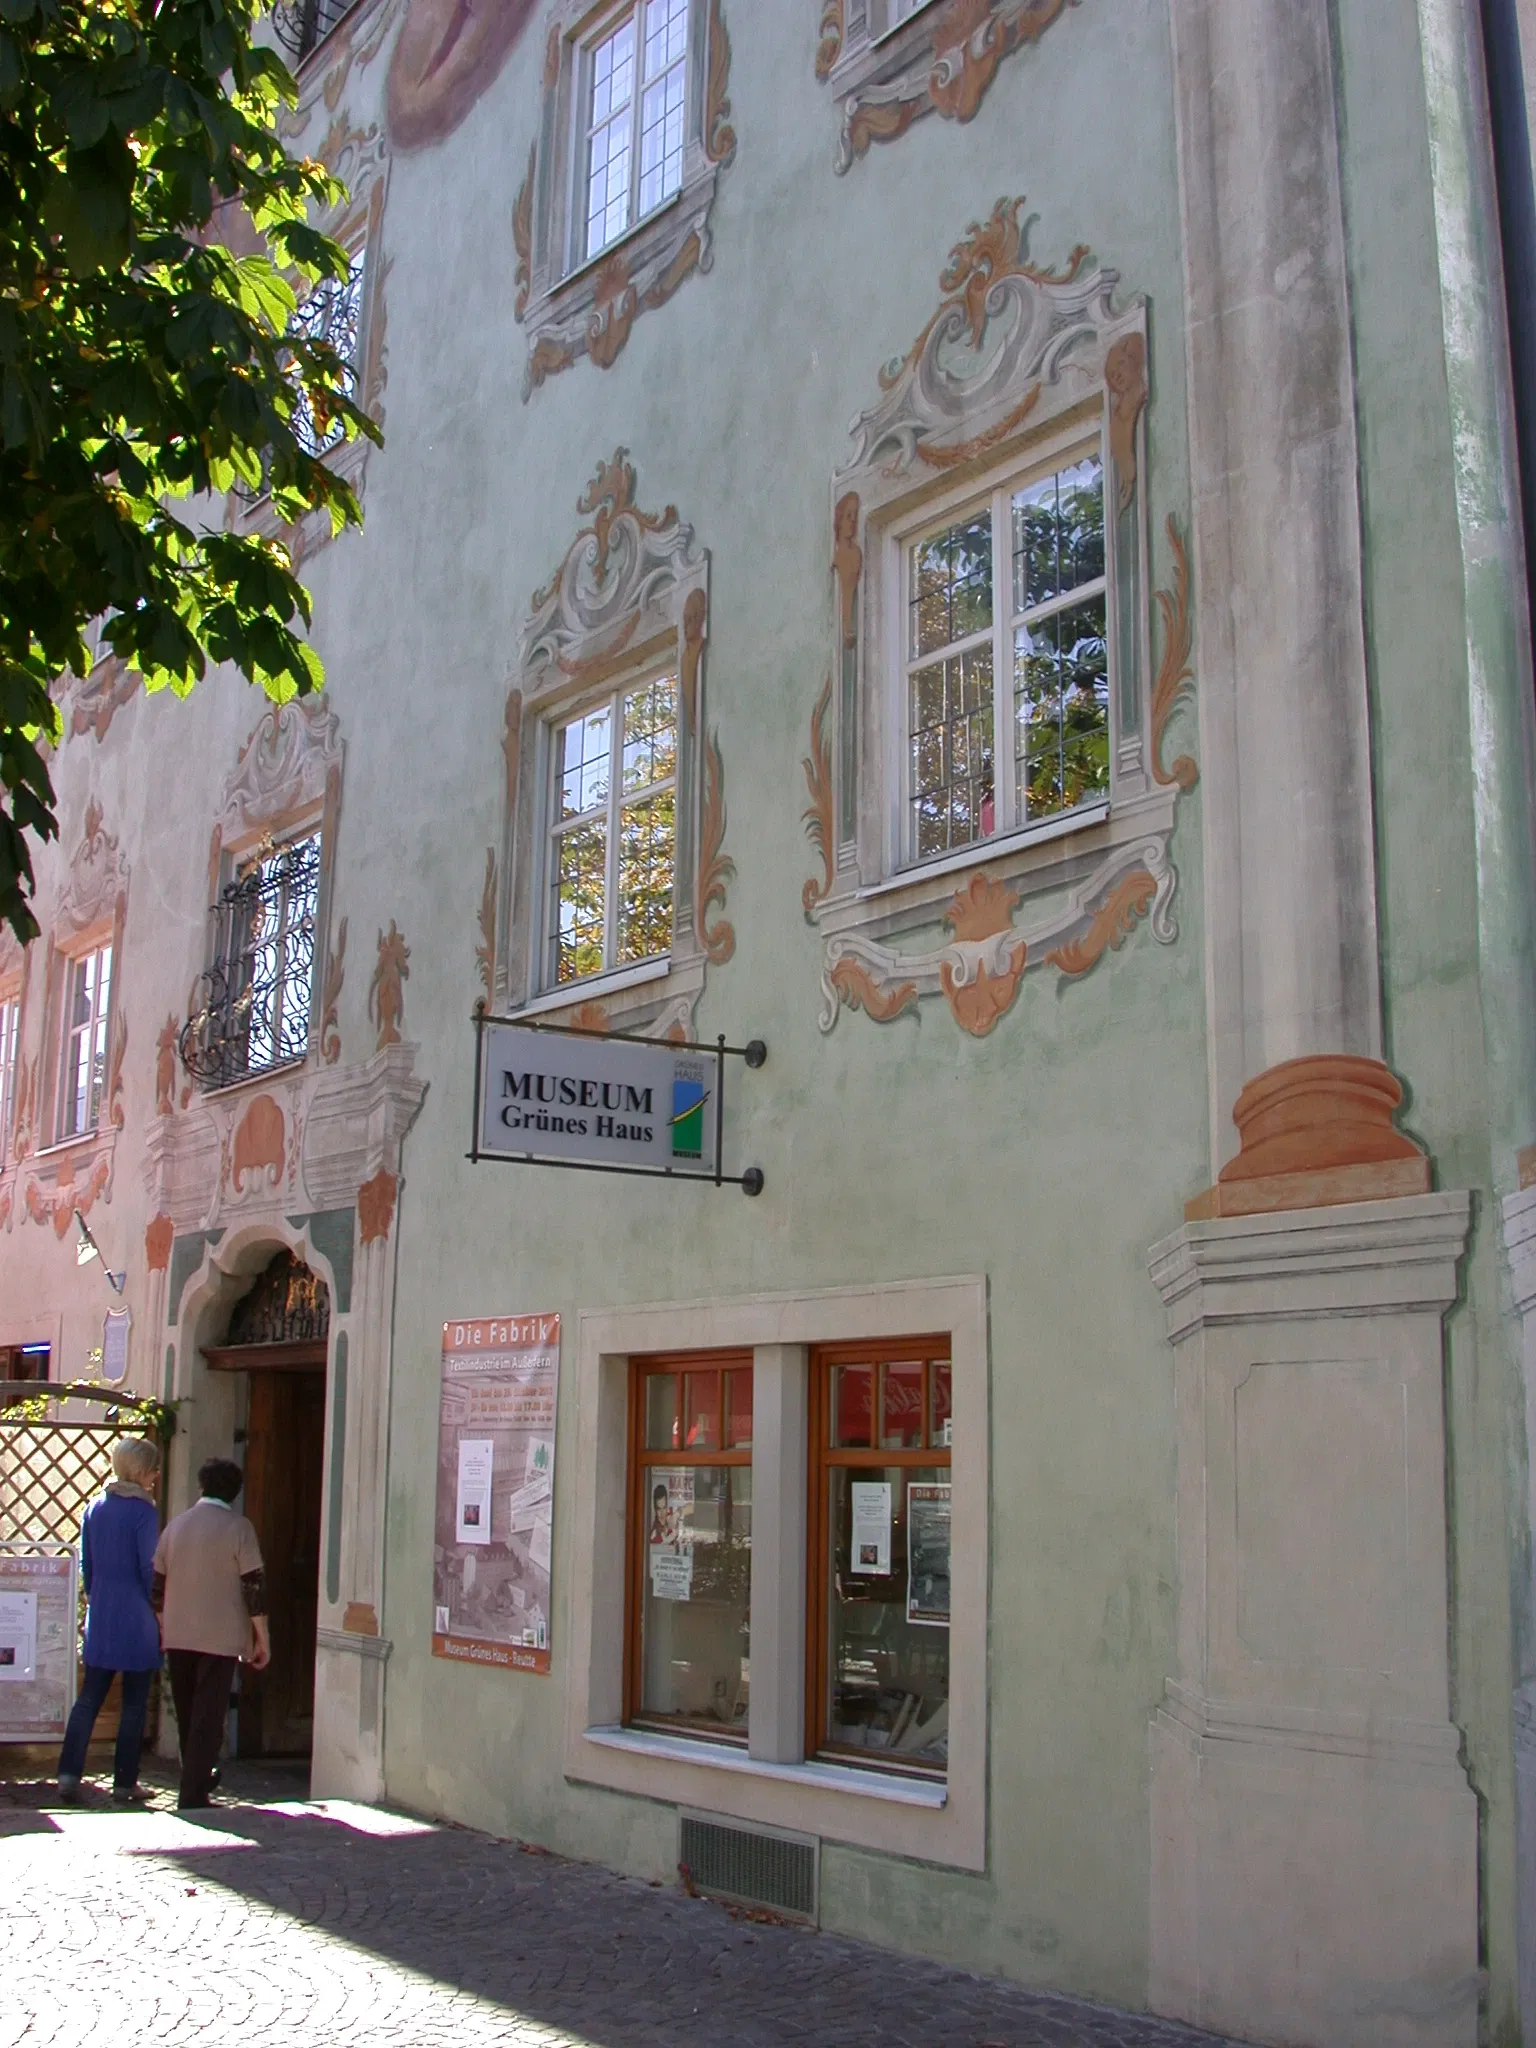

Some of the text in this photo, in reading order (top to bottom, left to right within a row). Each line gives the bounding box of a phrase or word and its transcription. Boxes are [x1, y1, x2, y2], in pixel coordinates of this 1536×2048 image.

[674, 1069, 705, 1082] HAUS
[501, 1070, 654, 1114] MUSEUM
[501, 1105, 653, 1142] Grünes Haus
[455, 1318, 549, 1346] Die Fabrik
[916, 1489, 930, 1499] Die
[445, 1640, 469, 1657] Museum
[470, 1644, 492, 1661] Grünes
[493, 1648, 509, 1664] Haus
